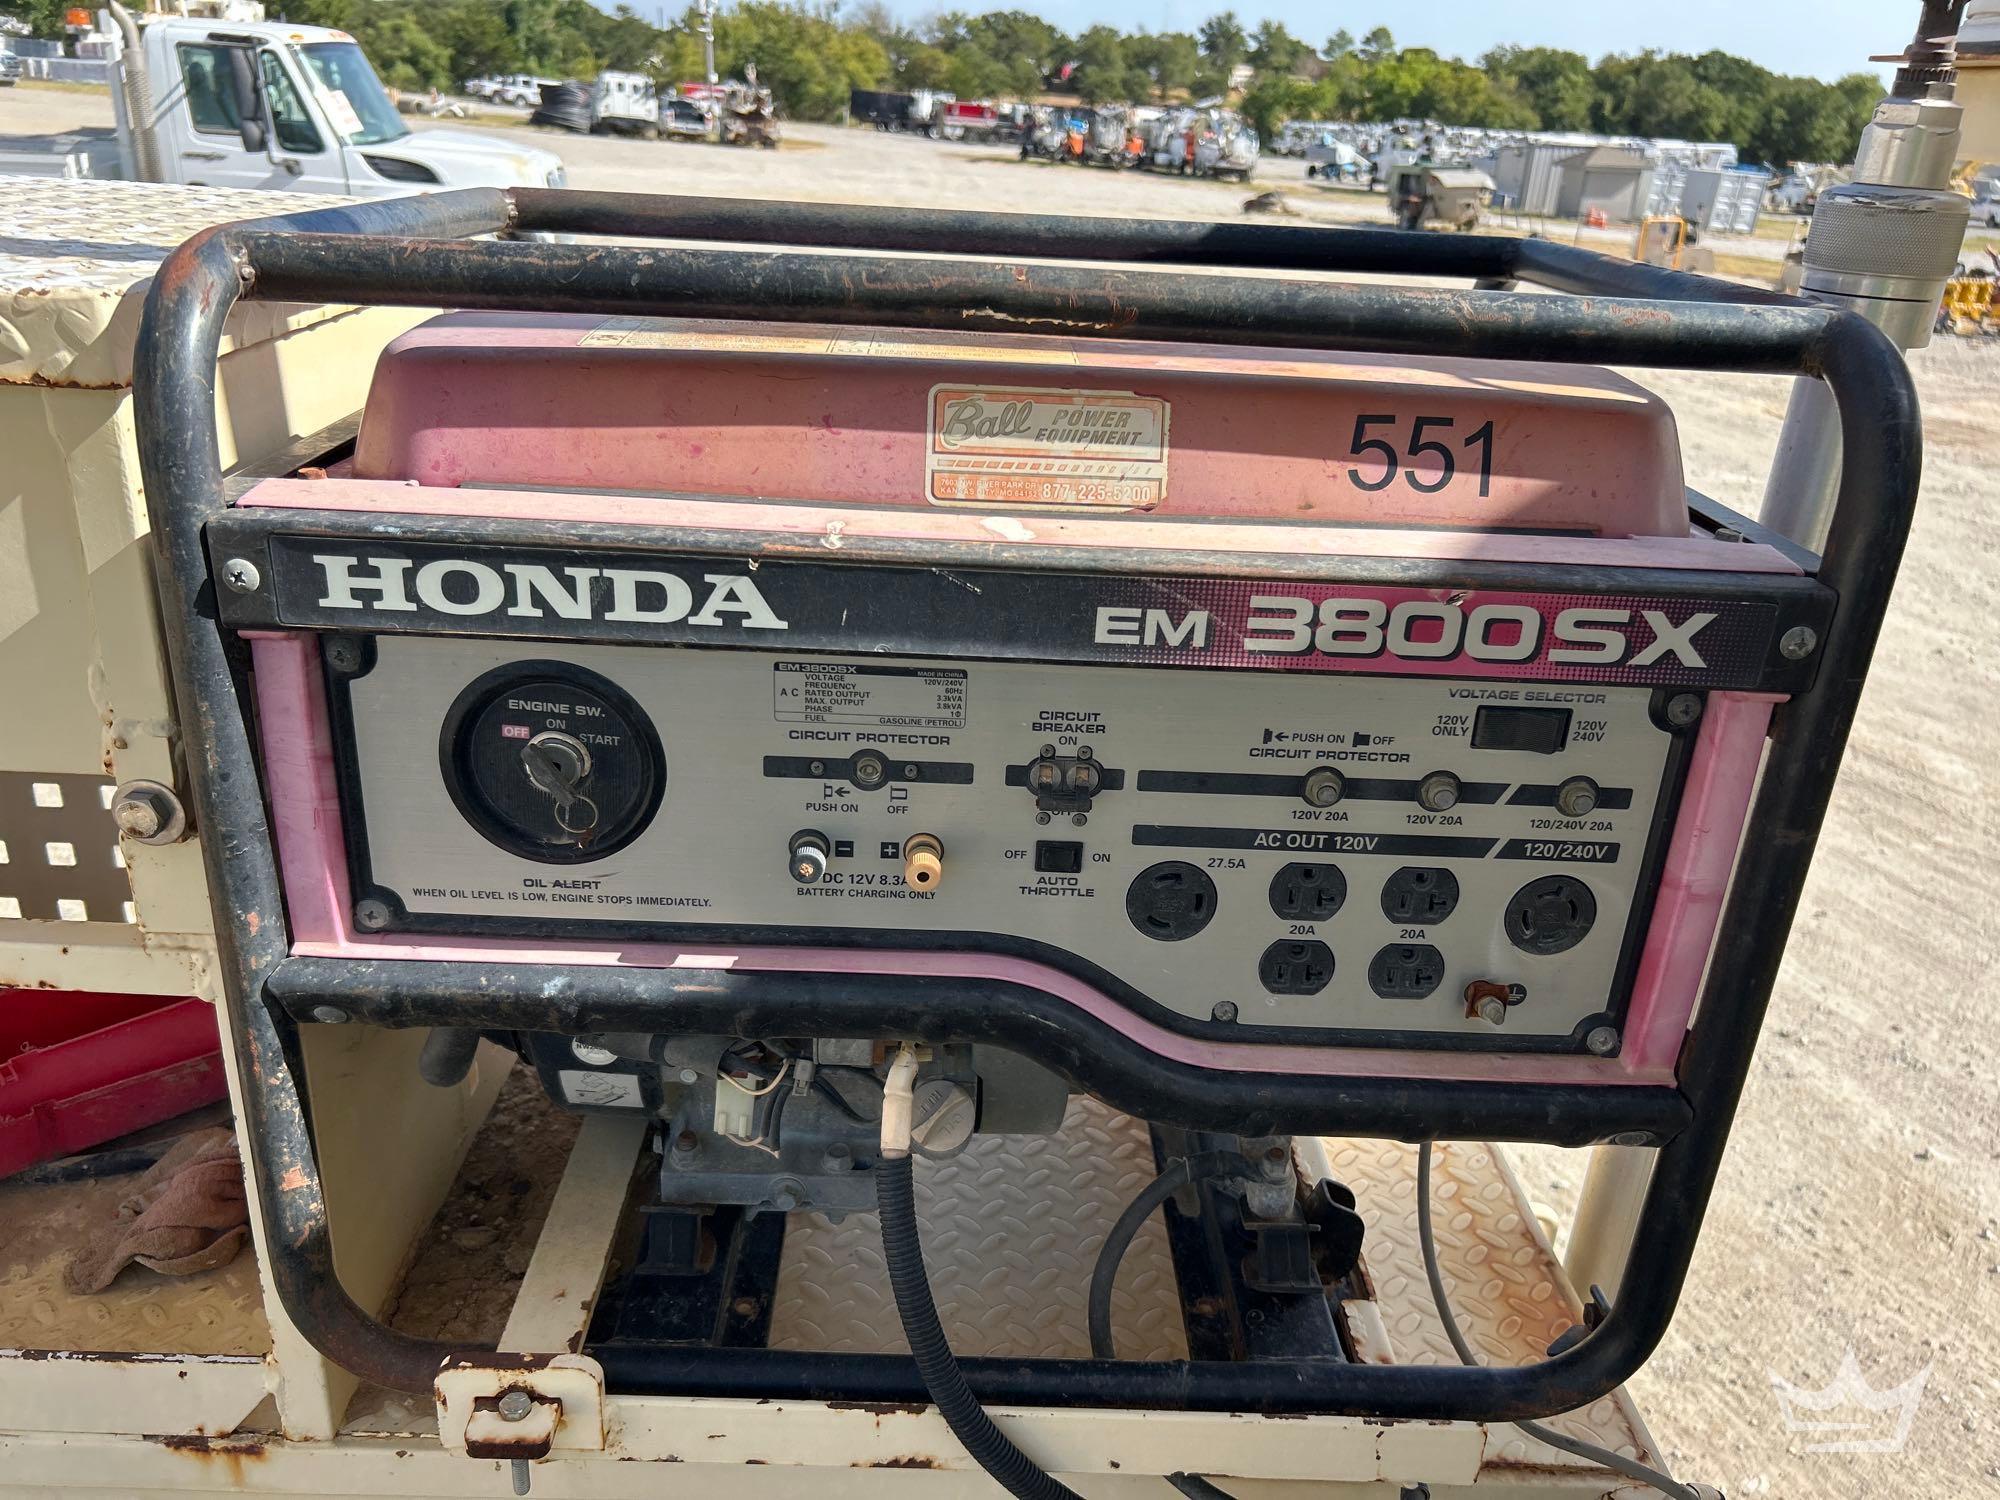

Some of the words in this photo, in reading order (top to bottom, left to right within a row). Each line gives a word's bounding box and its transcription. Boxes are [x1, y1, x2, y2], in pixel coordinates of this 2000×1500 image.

[943, 397, 1033, 447] Ball
[1052, 408, 1132, 429] POWER
[1035, 427, 1142, 446] EQUIPMENT
[1348, 414, 1494, 497] 551
[940, 486, 975, 496] KANSAS
[1002, 481, 1023, 489] PARK
[1042, 482, 1152, 502] 877-225-5200
[313, 555, 788, 630] HONDA
[1095, 607, 1209, 648] EM
[1243, 595, 1720, 669] 3800SX
[801, 664, 857, 674] 3800SX
[805, 673, 845, 682] VOLTAGE
[924, 678, 963, 687] 120V/240V
[805, 681, 857, 690] FREQUENCY
[945, 687, 963, 695] 60Hz
[805, 689, 833, 697] RATED
[835, 690, 871, 699] OUTPUT
[936, 694, 963, 703] 3.3kVA
[1448, 688, 1520, 701] VOLTAGE
[1524, 691, 1606, 704] SELECTOR
[805, 697, 828, 705] MAX.
[829, 698, 865, 706] OUTPUT
[508, 699, 570, 715] ENGINE
[575, 704, 606, 718] SW.
[805, 705, 833, 713] PHASE
[805, 714, 826, 722] FUEL
[880, 717, 923, 726] GASOLINE
[924, 719, 962, 727] (PETROL)
[1039, 710, 1101, 722] CIRCUIT
[1437, 715, 1469, 726] 120V
[546, 718, 566, 730] ON
[1032, 722, 1106, 734] BREAKER
[1576, 720, 1607, 731] 120V
[504, 726, 529, 738] OFF
[1431, 726, 1470, 737] ONLY
[1572, 731, 1605, 742] 240V
[579, 733, 621, 746] START
[788, 730, 851, 742] CIRCUIT
[855, 732, 950, 746] PROTECTOR
[1058, 735, 1078, 746] ON
[1291, 732, 1324, 743] PUSH
[1326, 734, 1345, 744] ON
[1372, 736, 1396, 746] OFF
[1249, 747, 1311, 760] CIRCUIT
[1315, 750, 1410, 763] PROTECTOR
[806, 802, 837, 812] PUSH
[840, 803, 859, 813] ON
[887, 805, 909, 815] OFF
[1291, 810, 1322, 820] 120V
[1324, 811, 1349, 822] 20A
[1406, 814, 1437, 825] 120V
[1438, 816, 1463, 826] 20A
[1529, 819, 1588, 831] 120/240V
[1589, 821, 1613, 832] 20A
[1253, 832, 1282, 848] AC
[1286, 833, 1328, 849] OUT
[1333, 836, 1379, 851] 120V
[1004, 850, 1027, 860] OFF
[1523, 842, 1608, 860] 120/240V
[1092, 853, 1111, 863] ON
[1207, 857, 1246, 869] 27.5A
[523, 878, 548, 889] OIL
[552, 879, 601, 891] ALERT
[822, 872, 844, 884] DC
[849, 873, 876, 885] 12V
[1036, 876, 1078, 886] AUTO
[412, 887, 447, 898] WHEN
[449, 889, 469, 898] OIL
[471, 890, 505, 900] LEVEL
[507, 891, 519, 901] IS
[551, 893, 594, 904] ENGINE
[597, 895, 633, 906] STOPS
[636, 896, 713, 908] IMMEDIATELY.
[797, 887, 845, 897] BATTERY
[848, 888, 906, 899] CHARGING
[908, 890, 936, 900] ONLY
[1019, 886, 1095, 898] THROTTLE
[1289, 924, 1315, 935] 20A
[1400, 929, 1426, 940] 20A
